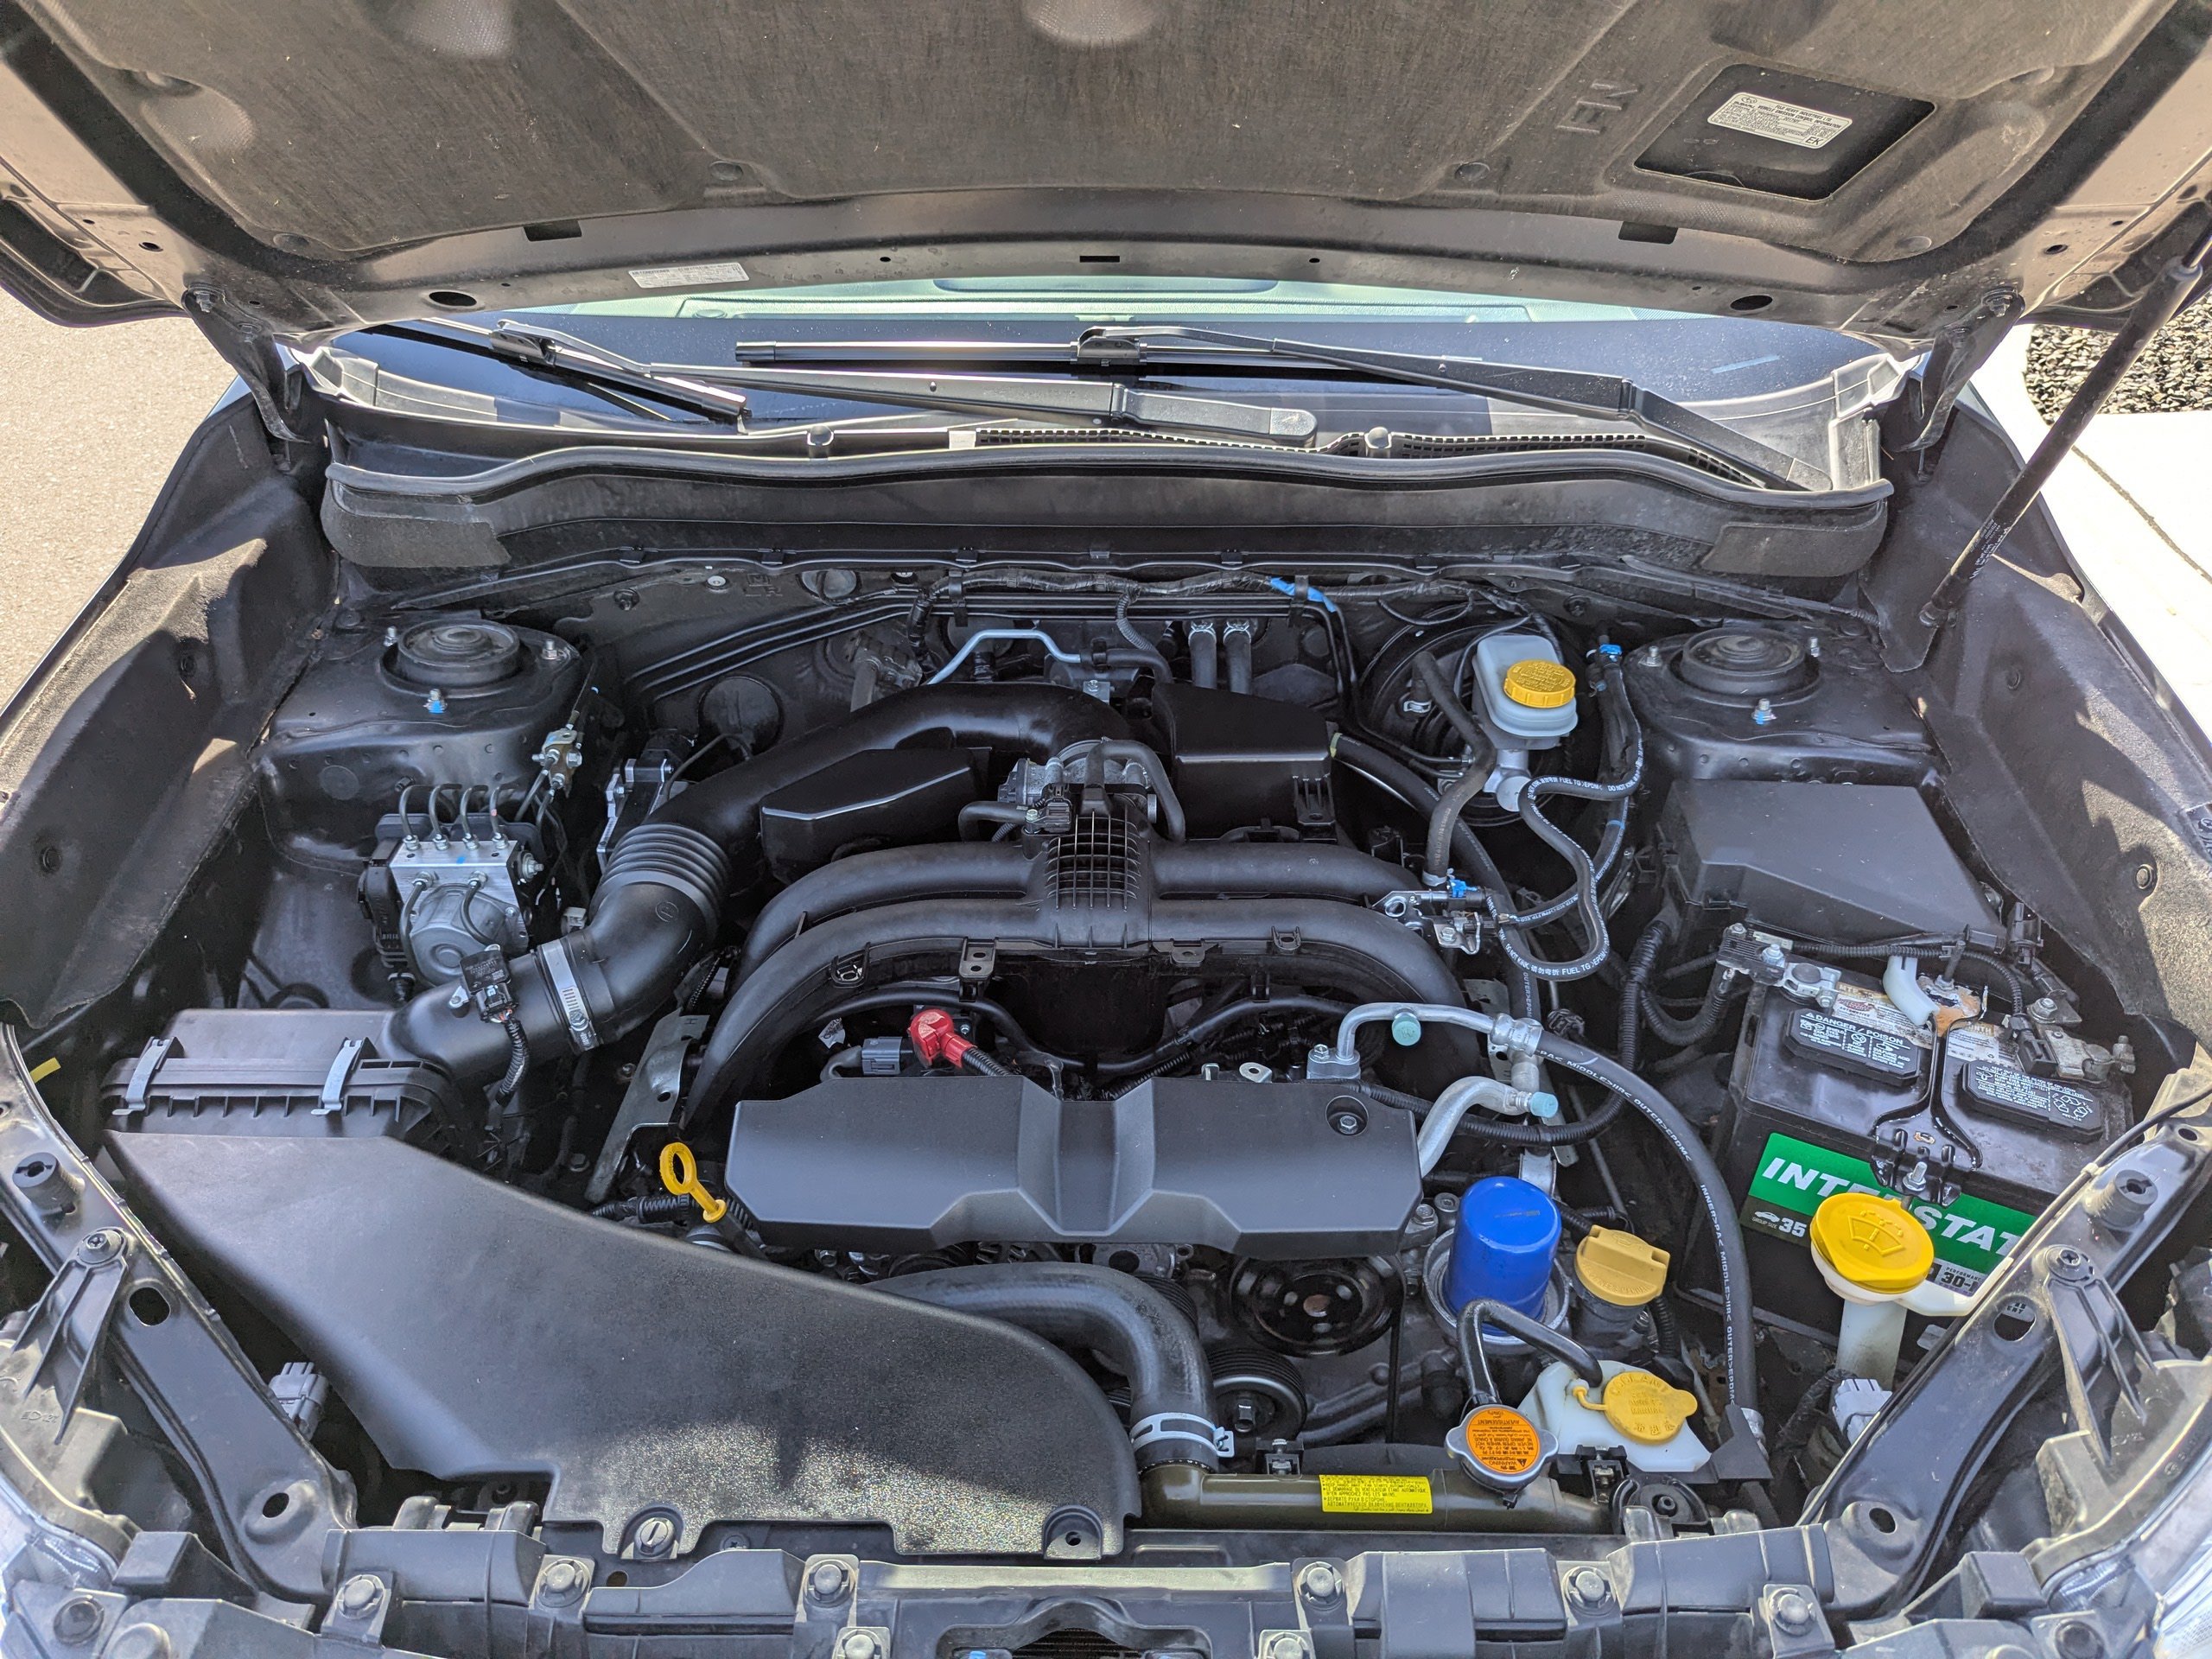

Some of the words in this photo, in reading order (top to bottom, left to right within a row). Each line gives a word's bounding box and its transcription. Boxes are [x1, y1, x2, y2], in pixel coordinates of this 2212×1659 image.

[1805, 136, 1824, 146] EK
[1561, 967, 1580, 976] FUEL
[1580, 963, 1591, 971] TG
[1815, 1014, 1857, 1032] DANGER
[1866, 1029, 1904, 1046] POISON
[1751, 1216, 1768, 1225] GROUP
[1778, 1217, 1808, 1237] 35
[1609, 1373, 1672, 1396] COOLANT
